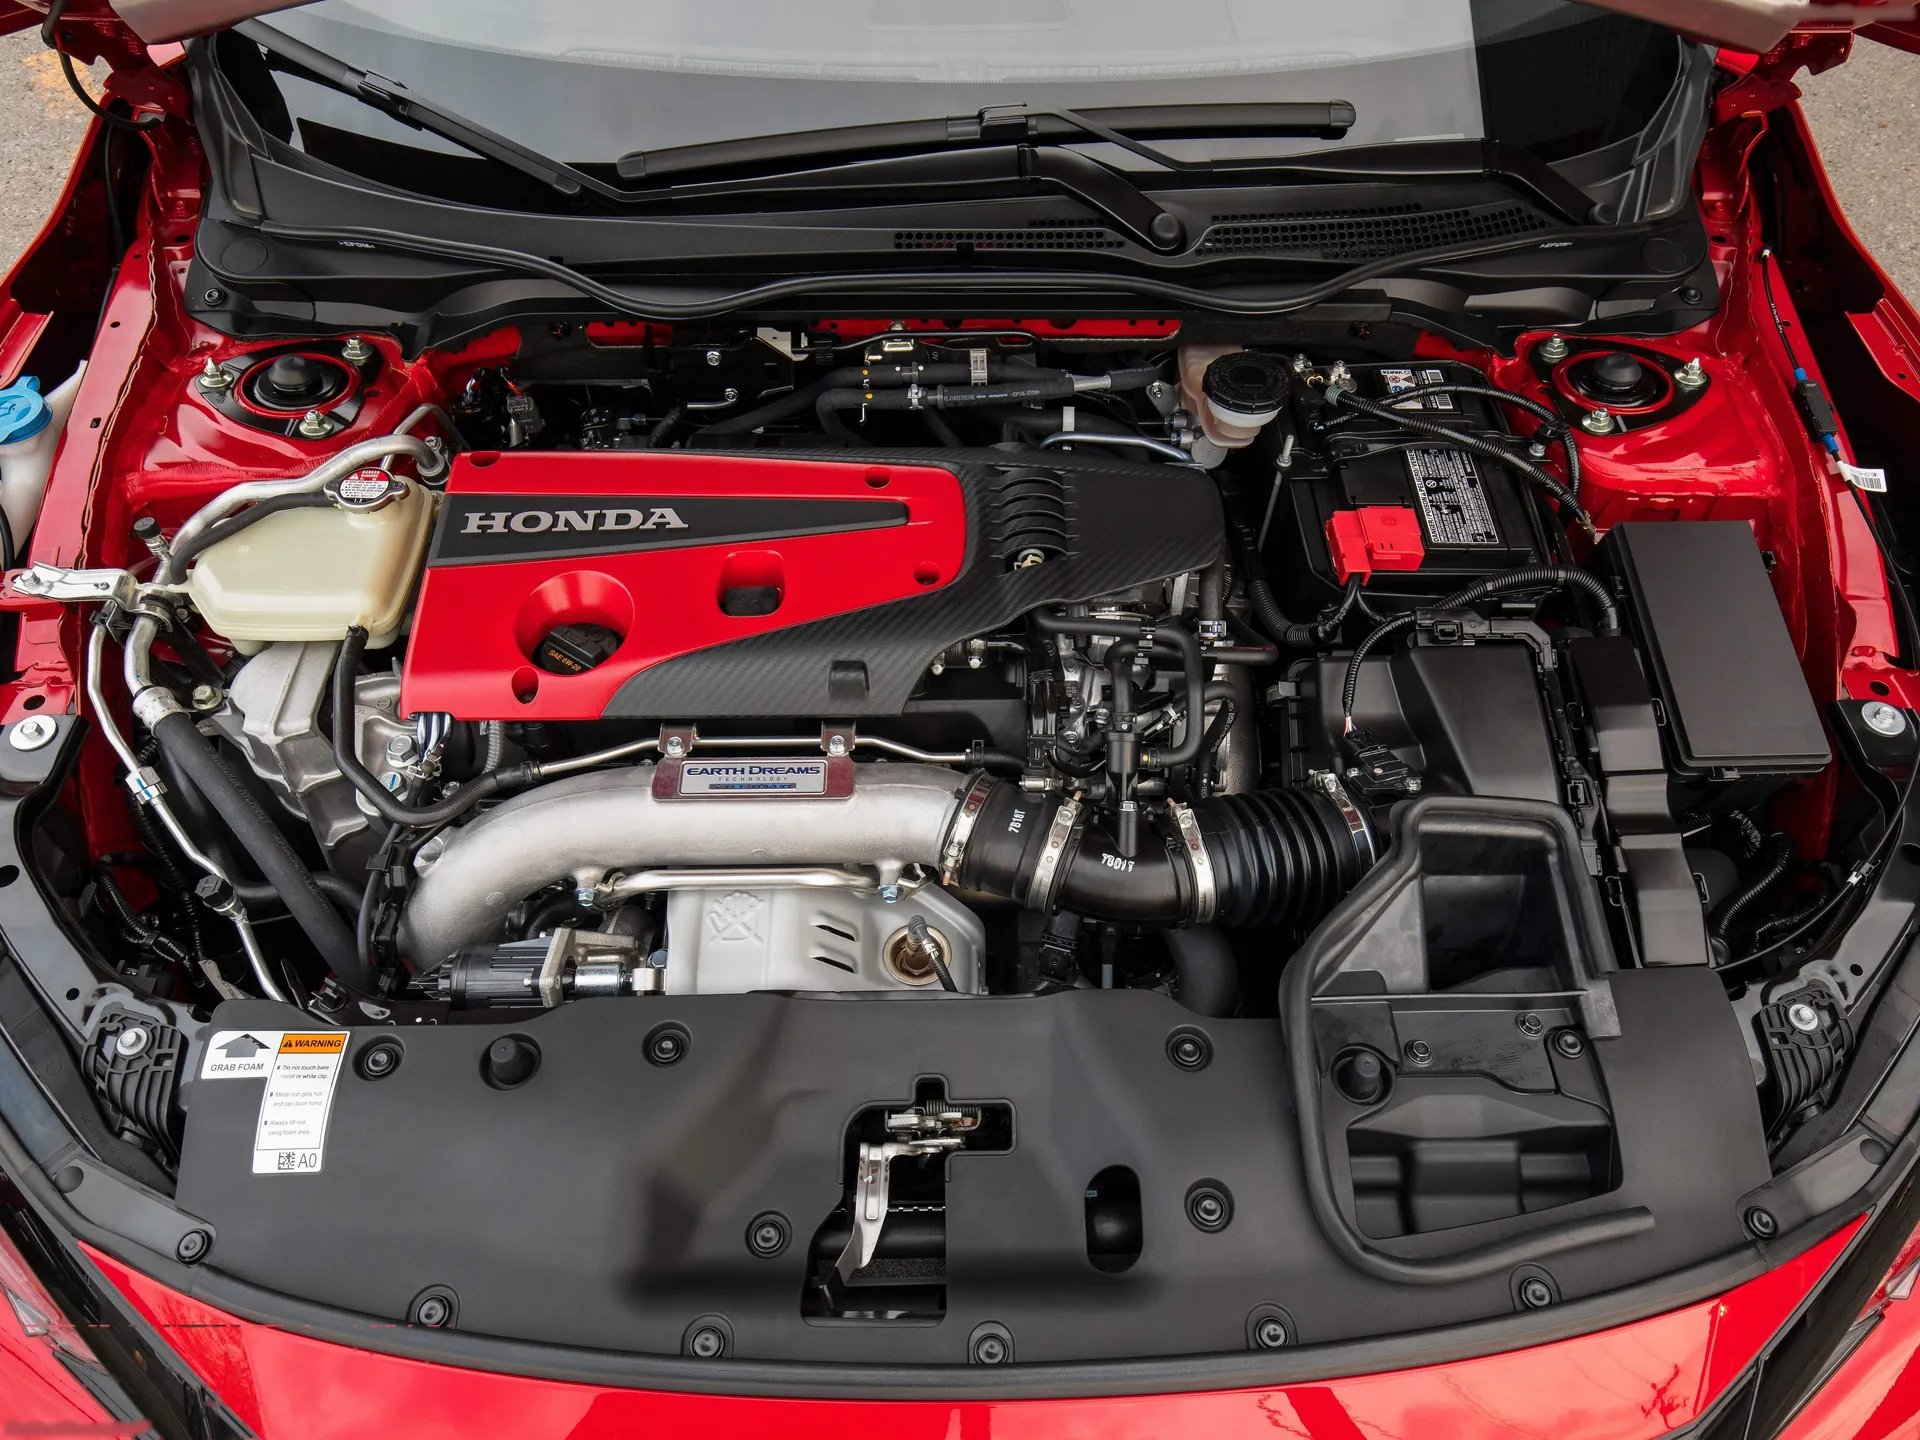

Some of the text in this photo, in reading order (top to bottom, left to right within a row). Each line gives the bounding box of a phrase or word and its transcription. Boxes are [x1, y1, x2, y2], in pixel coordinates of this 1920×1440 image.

[460, 508, 689, 533] HONDA
[548, 649, 582, 672] SAE 0W-20
[686, 765, 820, 776] EARTH DREAMS
[294, 1039, 342, 1048] WARNING
[210, 1063, 265, 1072] GRAB FOAM
[297, 1152, 317, 1168] A0
